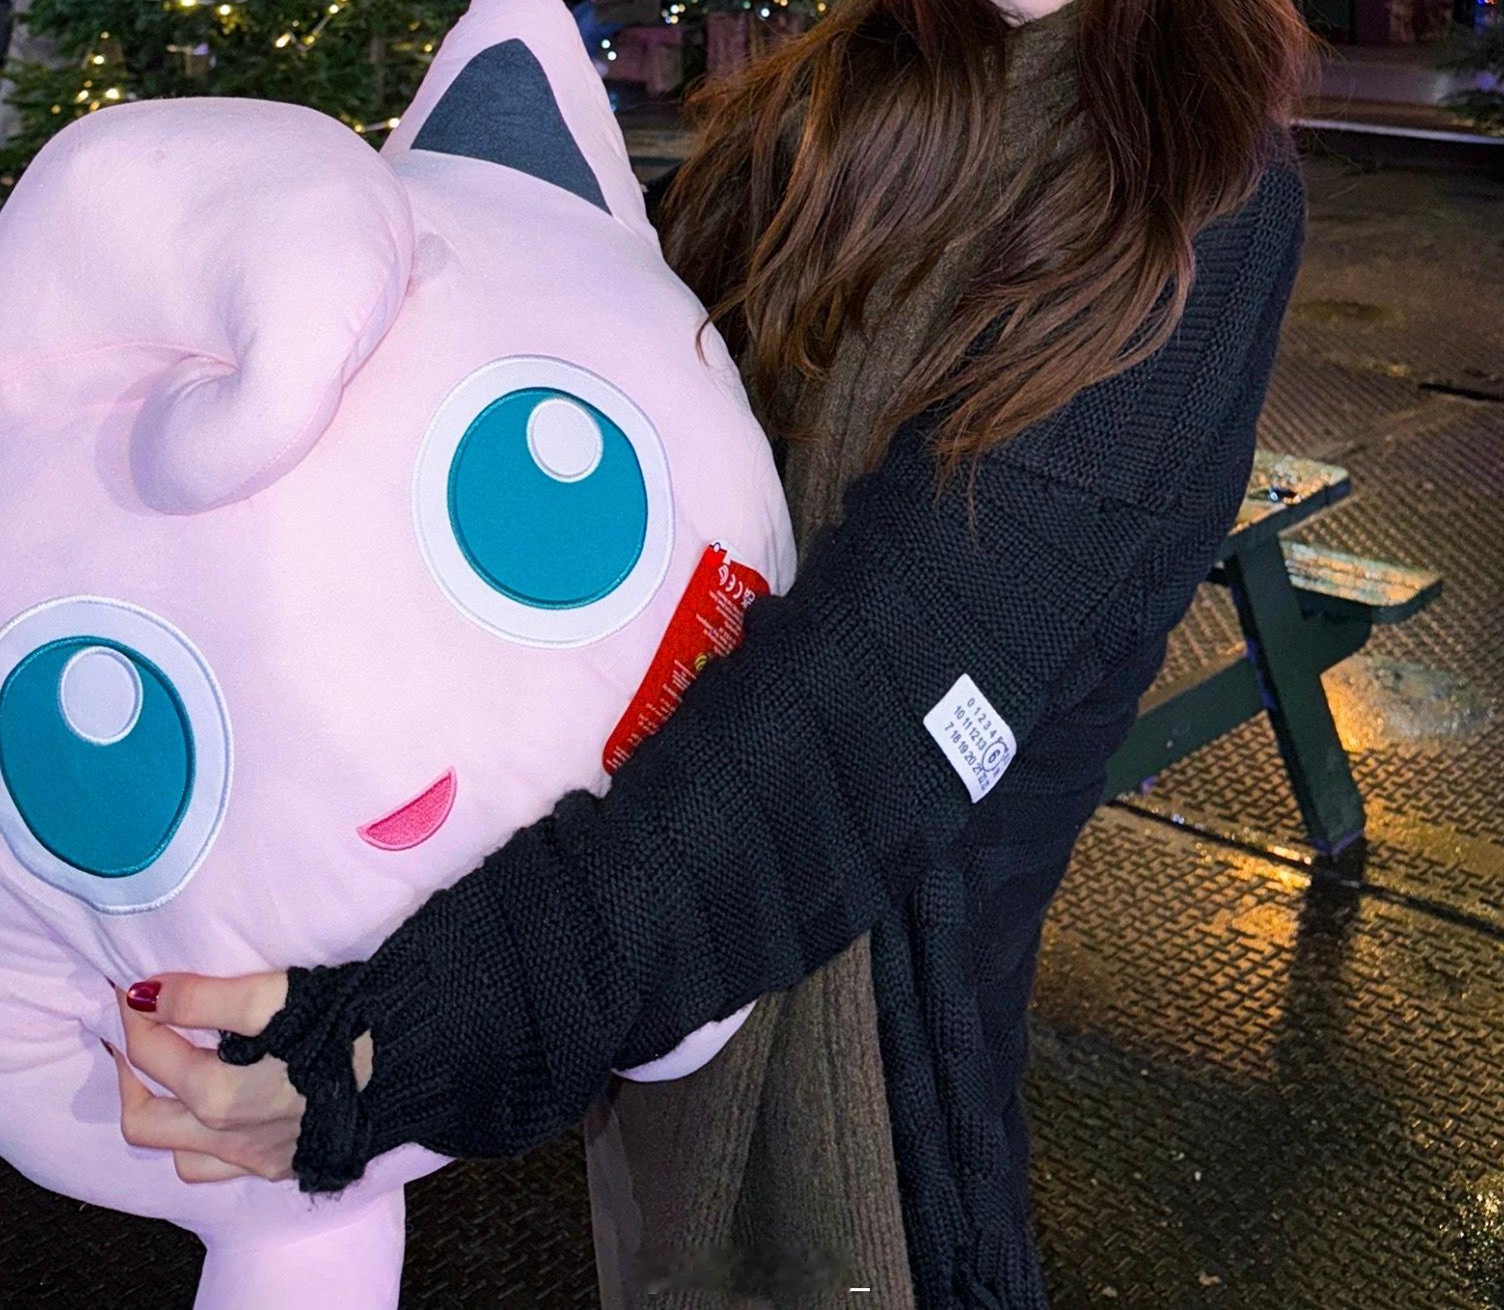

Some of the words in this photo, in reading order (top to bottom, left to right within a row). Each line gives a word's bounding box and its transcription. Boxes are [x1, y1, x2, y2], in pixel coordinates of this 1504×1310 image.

[966, 697, 975, 708] 0
[974, 707, 981, 716] 1
[977, 713, 987, 724] 2
[983, 720, 992, 730] 3
[953, 706, 966, 720] 10
[962, 717, 973, 730] 11
[969, 727, 981, 742] 12
[975, 737, 987, 751] 13
[988, 750, 1001, 764] 6
[989, 730, 998, 738] 4
[951, 730, 962, 744] 18
[958, 741, 969, 754] 19
[965, 751, 977, 766] 20
